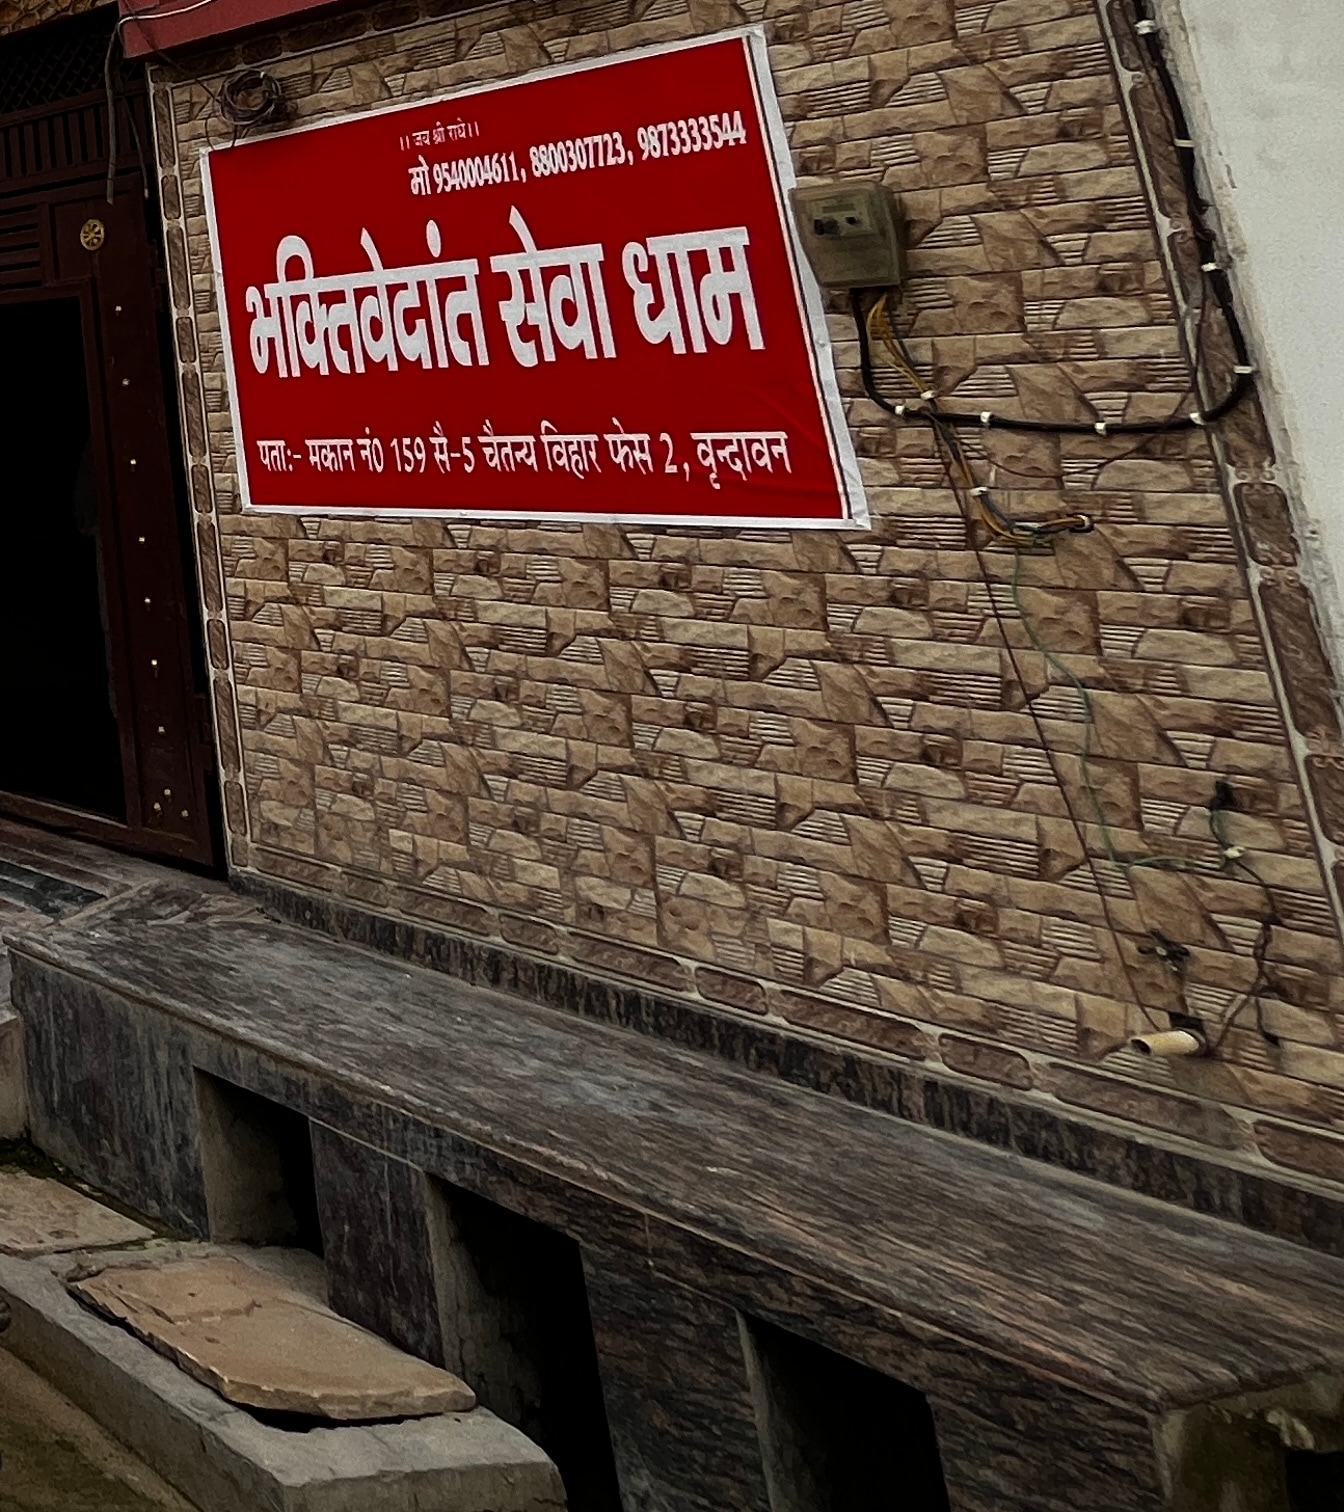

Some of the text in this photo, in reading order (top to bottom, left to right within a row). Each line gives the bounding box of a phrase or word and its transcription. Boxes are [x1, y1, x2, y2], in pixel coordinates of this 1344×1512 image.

[408, 110, 747, 196] मो 9540004611, 8800307723, 9873333544
[412, 131, 431, 147] जय
[245, 204, 766, 379] भक्तिवेदांत सेवा धाम
[304, 438, 356, 473] मकान
[389, 435, 427, 474] 159
[476, 418, 539, 473] चैतन्य
[539, 418, 603, 480] विहार
[603, 416, 655, 476] फेस
[659, 432, 690, 483] 2,
[689, 430, 793, 490] वृन्दावन
